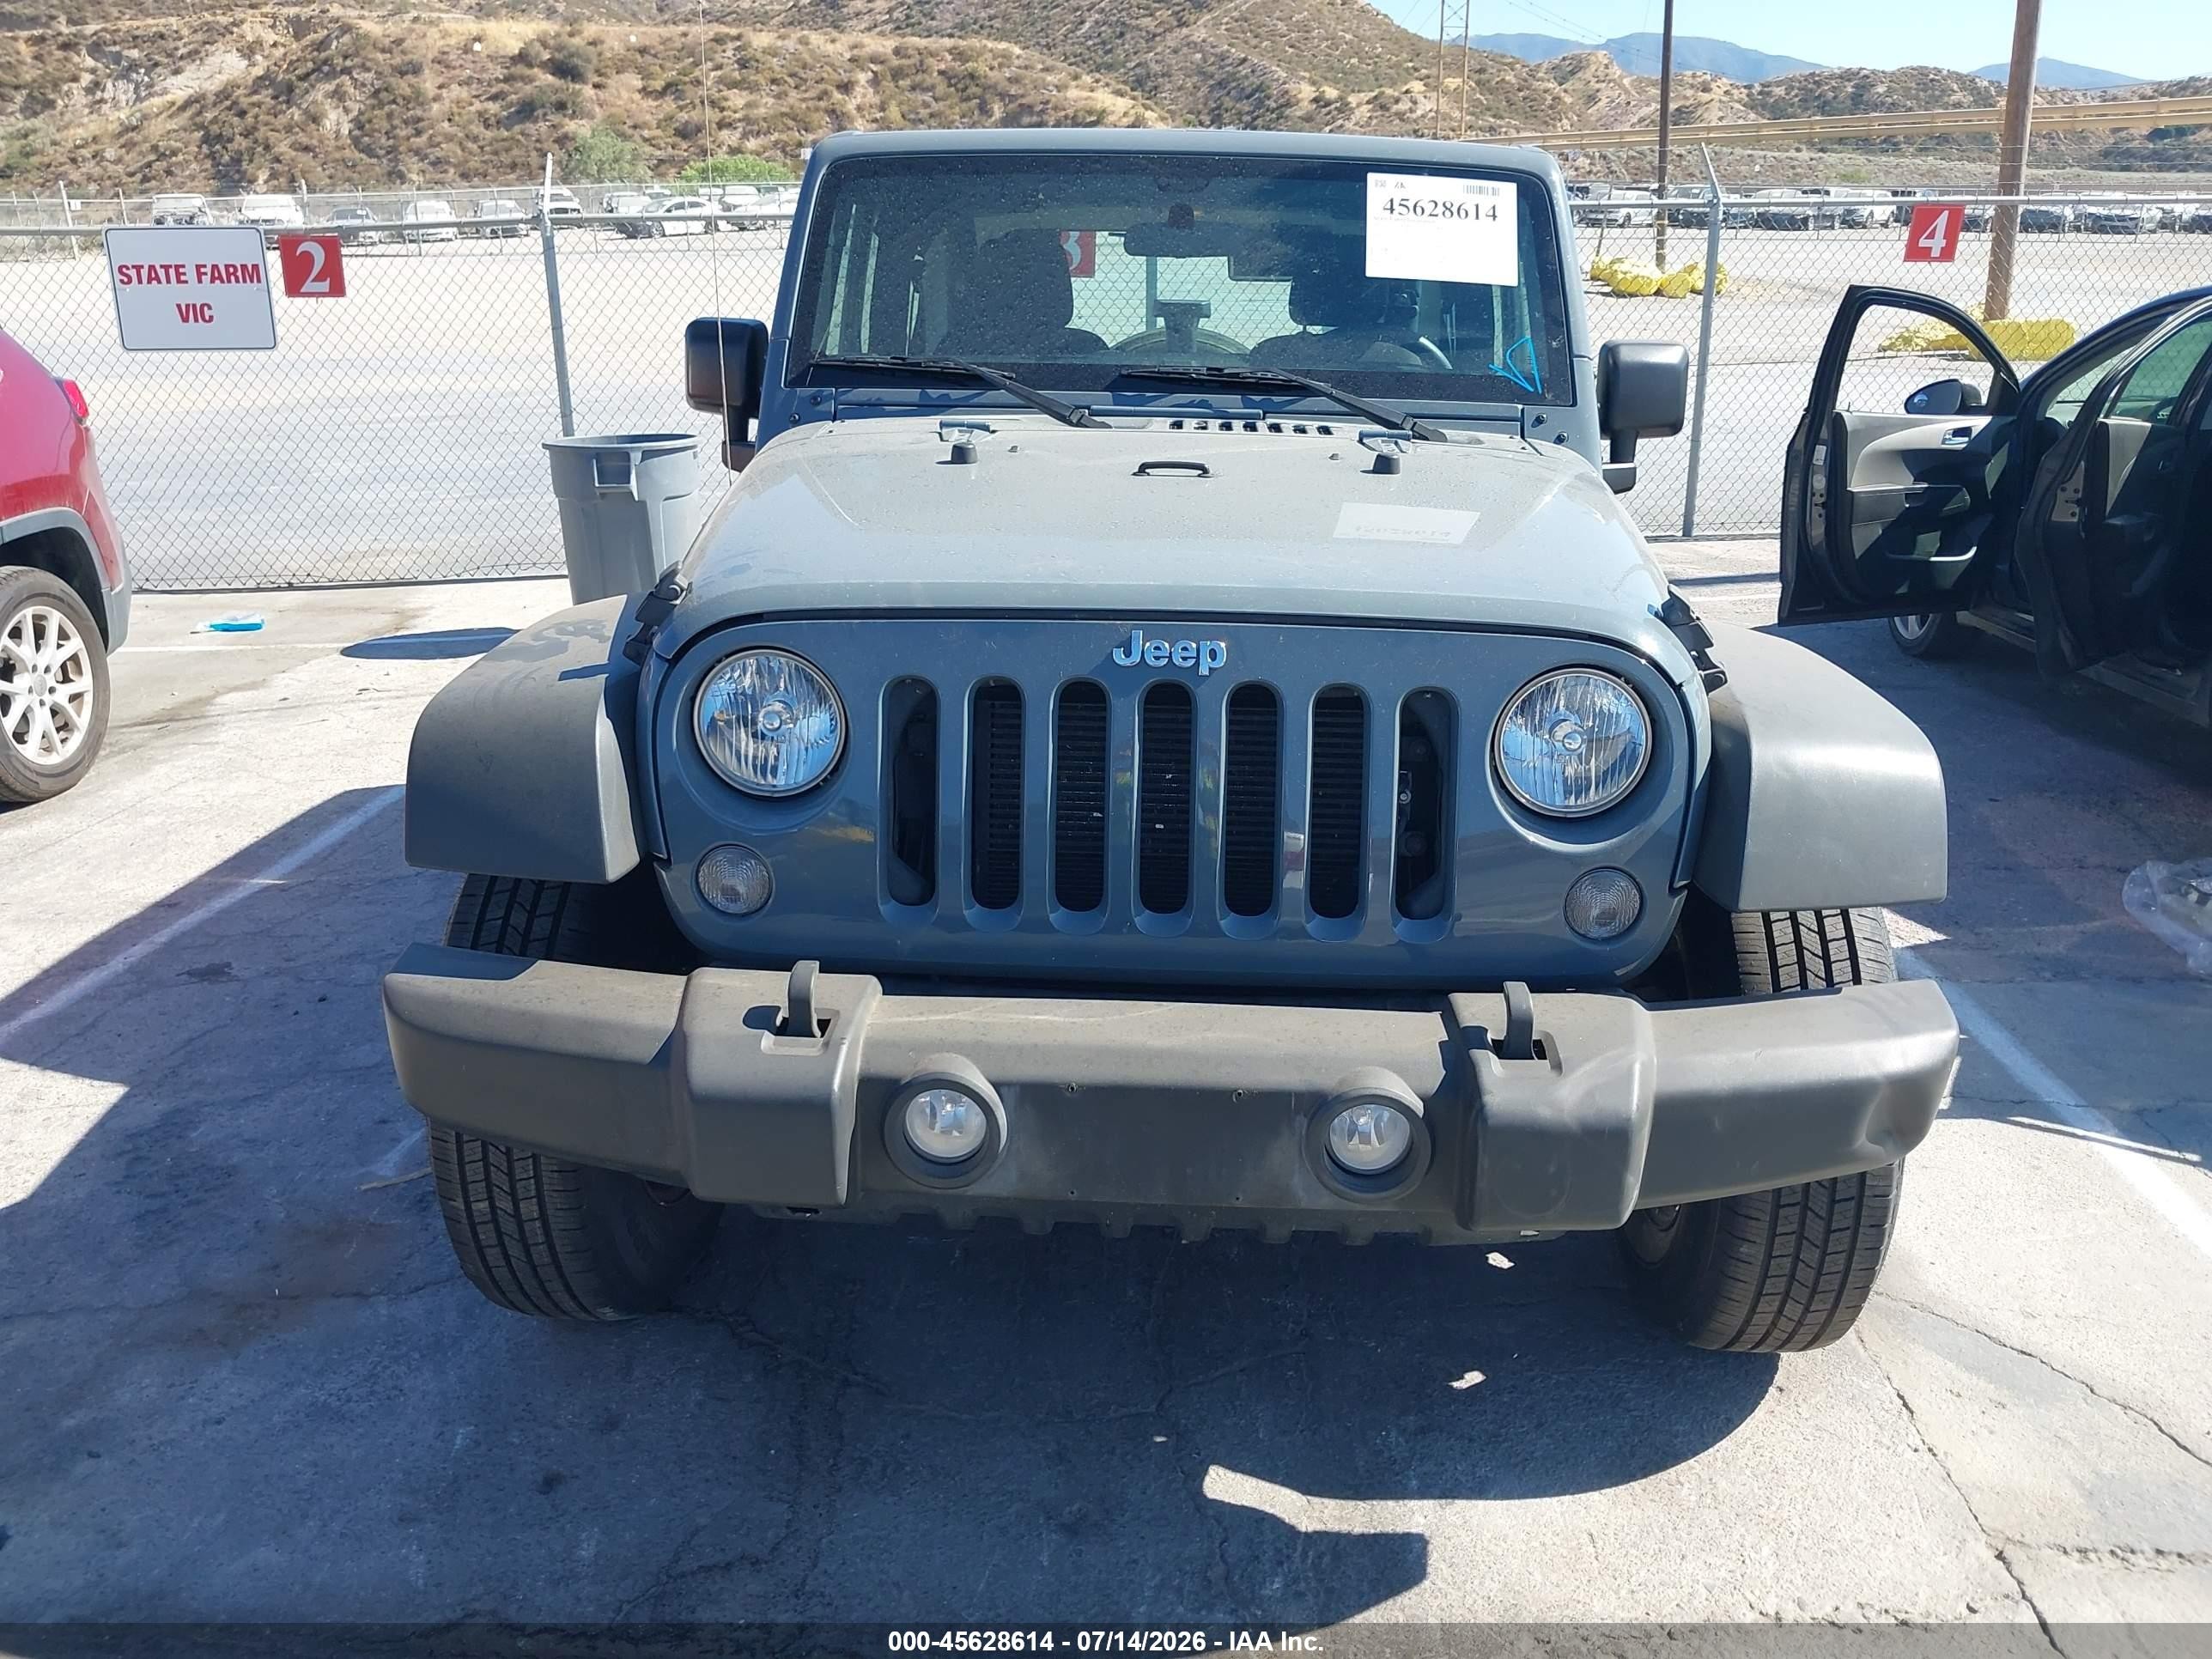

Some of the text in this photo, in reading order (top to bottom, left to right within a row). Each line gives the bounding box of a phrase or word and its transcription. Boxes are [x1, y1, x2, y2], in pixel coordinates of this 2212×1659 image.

[1382, 197, 1498, 222] 45628614
[1917, 210, 1949, 258] 4
[117, 263, 263, 286] STATE FARM
[295, 240, 331, 294] 2
[175, 302, 215, 324] VIC
[1112, 629, 1227, 677] Jeep
